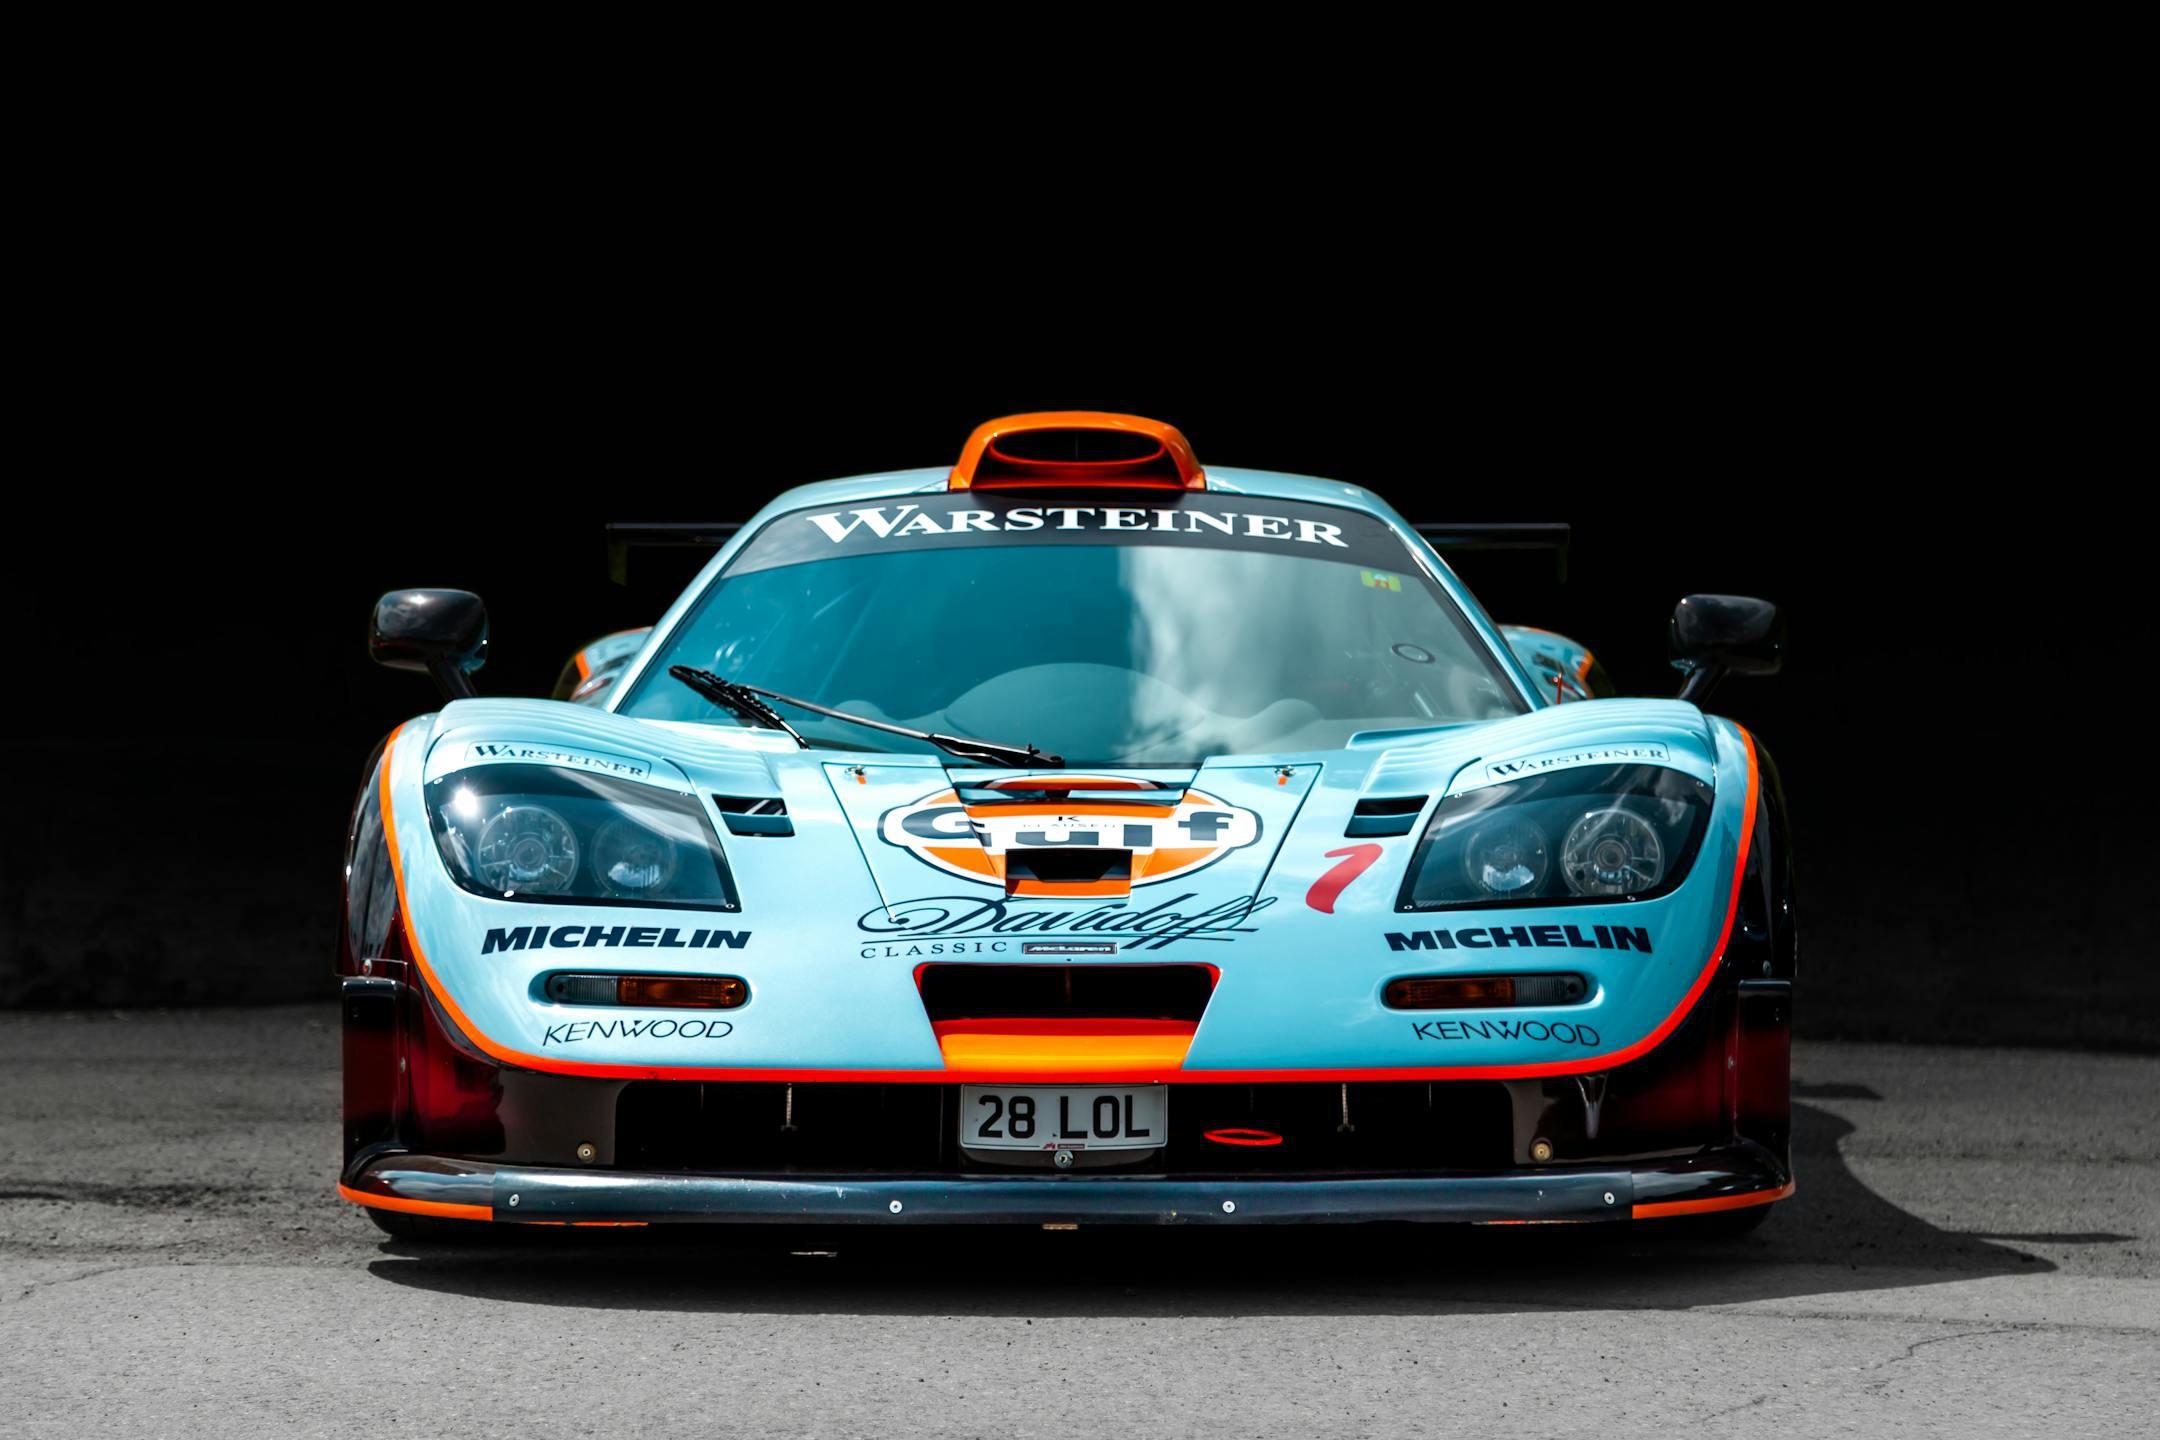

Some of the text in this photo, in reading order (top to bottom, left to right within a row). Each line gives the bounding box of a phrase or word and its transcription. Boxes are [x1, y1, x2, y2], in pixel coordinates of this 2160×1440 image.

[805, 505, 1350, 549] WARSTEINER
[474, 744, 643, 777] WARSTEINER
[1492, 748, 1664, 777] WARSTEINER
[901, 806, 1234, 848] Gulf
[857, 893, 1278, 950] Davidoff
[480, 925, 752, 955] MICHELIN
[861, 941, 1008, 959] CLASSIC
[1384, 925, 1653, 953] MICHELIN
[542, 1019, 734, 1046] KENWOOD
[1412, 1020, 1601, 1047] KENWOOD
[978, 1095, 1150, 1139] 28 LOL
